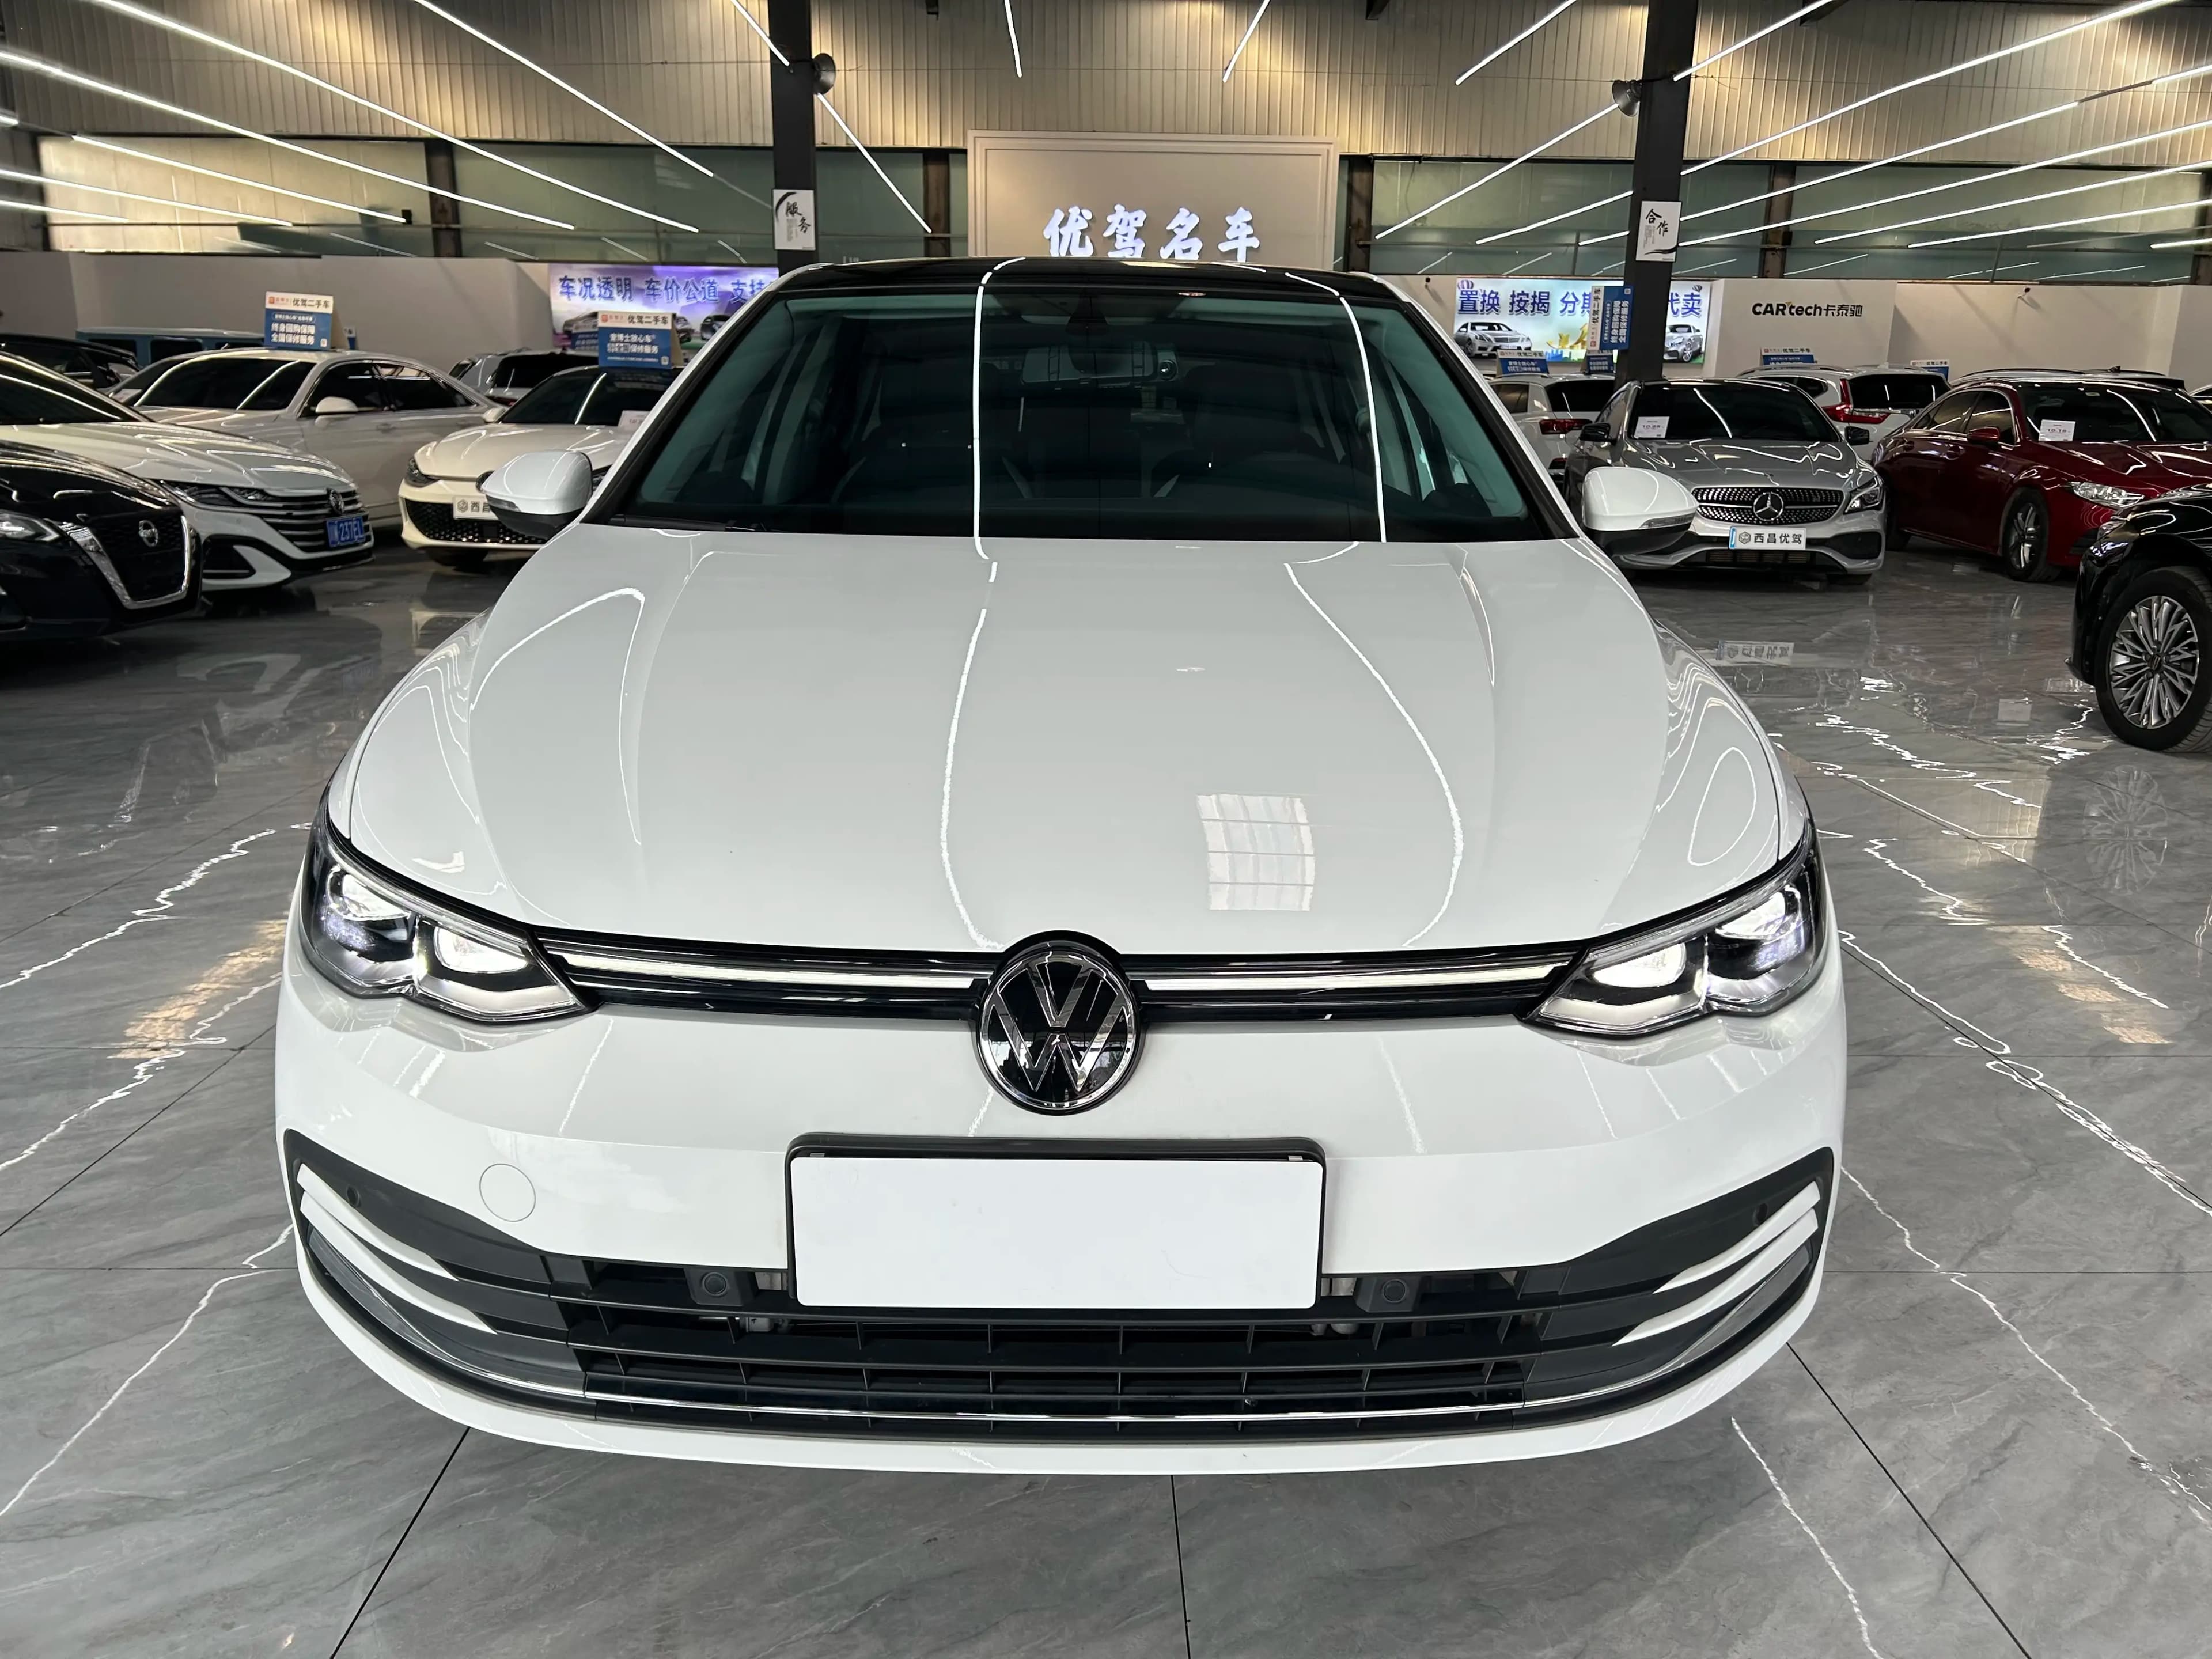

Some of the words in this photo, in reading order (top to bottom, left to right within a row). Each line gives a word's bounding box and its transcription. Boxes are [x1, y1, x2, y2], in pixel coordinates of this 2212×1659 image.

[785, 202, 811, 233] 服务
[1646, 209, 1668, 237] 合作
[1043, 204, 1260, 263] 优驾名车
[559, 276, 634, 302] 车况透明
[645, 278, 719, 304] 车价公道
[729, 279, 774, 303] 支持
[1459, 290, 1501, 315] 置换
[1509, 291, 1550, 315] 按揭
[1754, 533, 1802, 544] 西昌优驾
